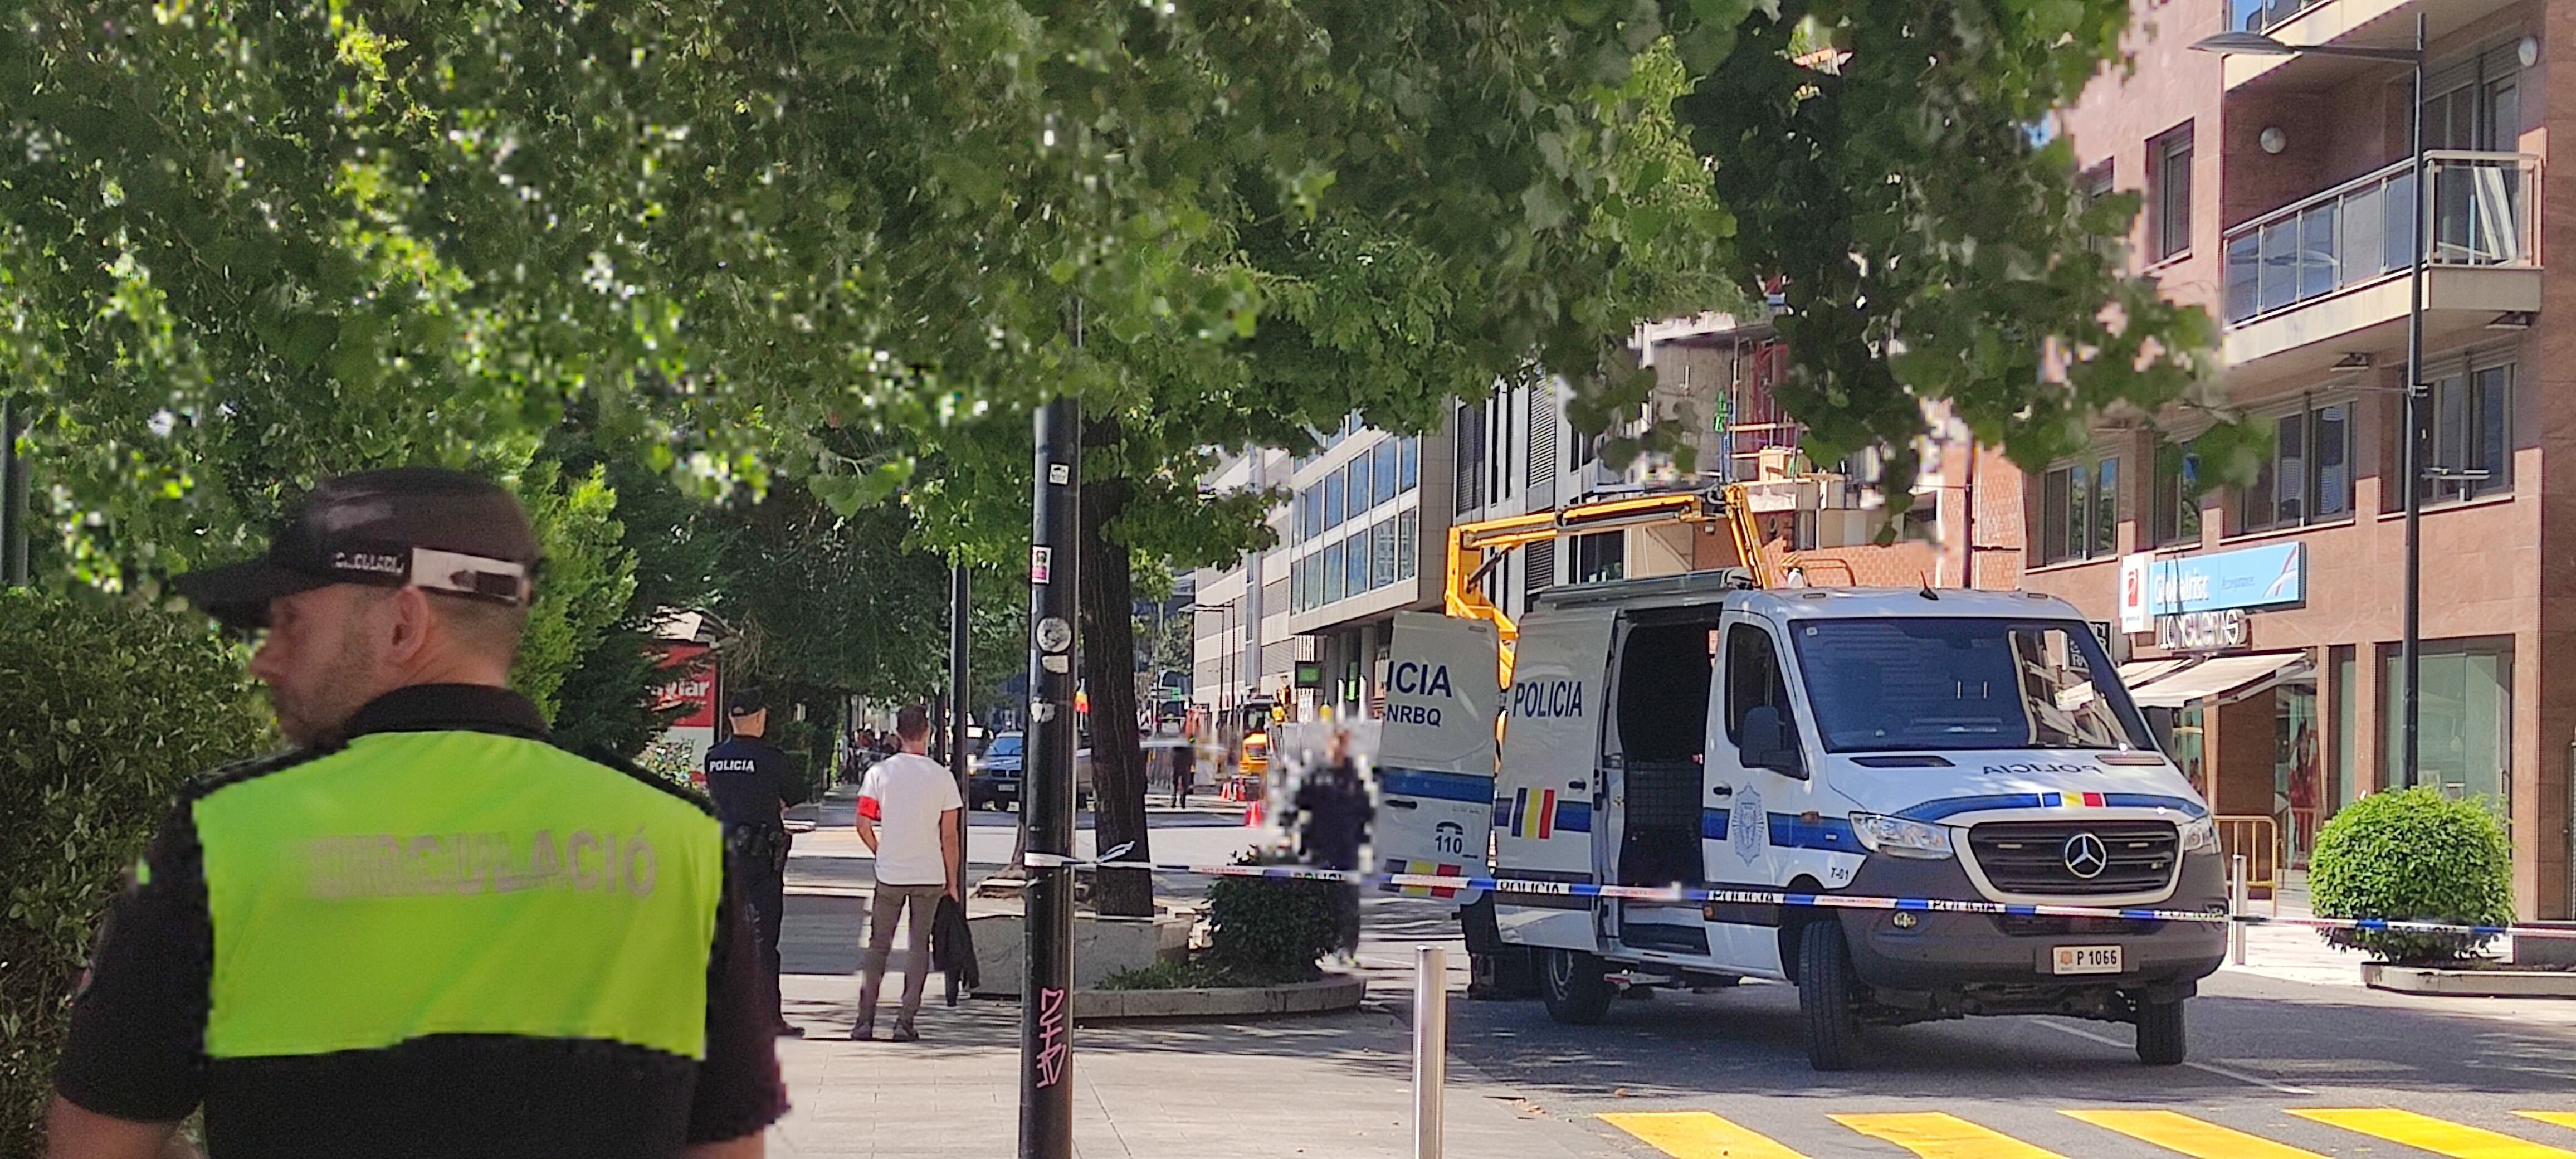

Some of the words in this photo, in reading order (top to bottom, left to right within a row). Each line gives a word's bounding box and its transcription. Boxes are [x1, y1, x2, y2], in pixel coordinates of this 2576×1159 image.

[1513, 681, 1583, 718] POLICIA
[709, 759, 755, 773] POLICIA
[1435, 835, 1462, 854] 110
[2077, 951, 2084, 965] P
[2089, 950, 2116, 965] 1066
